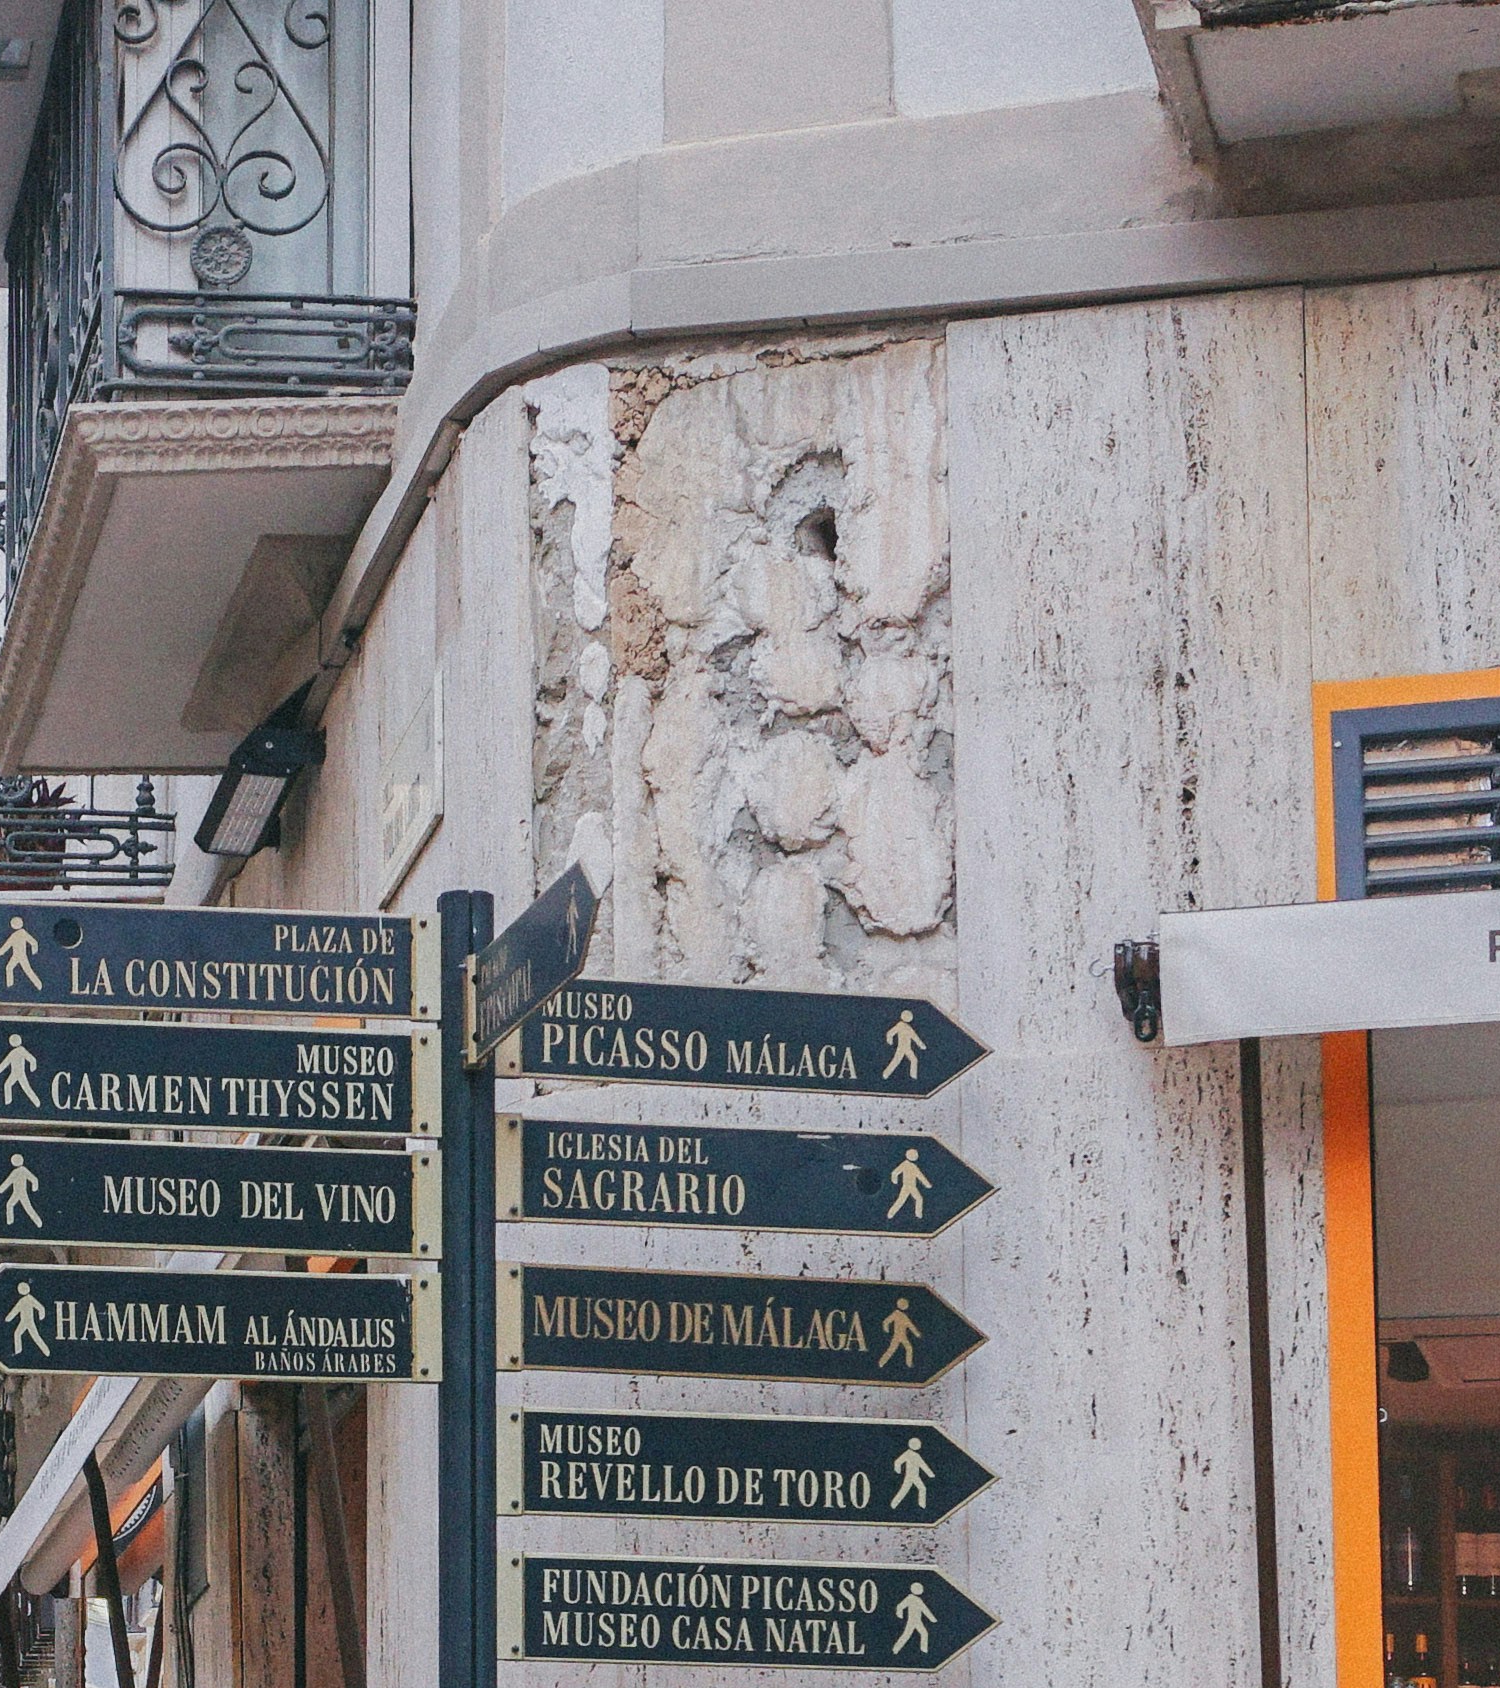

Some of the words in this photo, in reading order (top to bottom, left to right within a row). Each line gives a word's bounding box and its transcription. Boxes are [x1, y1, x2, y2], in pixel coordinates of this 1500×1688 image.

[274, 923, 352, 955] PLAZA
[362, 926, 395, 956] DE
[69, 956, 112, 996] LA
[124, 957, 395, 1005] CONSTITUCIÓN
[542, 991, 633, 1022] MUSEO
[296, 1043, 394, 1078] MUSEO
[541, 1023, 708, 1072] PICASSO
[726, 1033, 858, 1080] MÁLAGA
[50, 1071, 212, 1114] CARMEN
[221, 1077, 394, 1122] THYSSEN
[546, 1131, 650, 1163] IGLESIA
[658, 1136, 709, 1166] DEL
[102, 1174, 222, 1218] MUSEO
[240, 1180, 304, 1221] DEL
[315, 1184, 397, 1224] VINO
[542, 1166, 747, 1218] SAGRARIO
[53, 1300, 227, 1346] HAMMAM
[243, 1315, 277, 1346] AL
[282, 1310, 396, 1348] ÁNDALUS
[533, 1294, 662, 1342] MUSEO
[669, 1301, 715, 1344] DE
[721, 1297, 870, 1352] MÁLAGA
[254, 1348, 316, 1372] BAÑOS
[321, 1349, 396, 1374] ÁRABES
[540, 1423, 642, 1457] MUSEO
[540, 1461, 707, 1504] REVELLO
[716, 1466, 765, 1506] DE
[772, 1469, 871, 1509] TORO
[542, 1564, 733, 1609] FUNDACIÓN
[741, 1575, 879, 1613] PICASSO
[541, 1610, 662, 1649] MUSEO
[671, 1615, 755, 1653] CASA
[764, 1618, 866, 1657] NATAL
